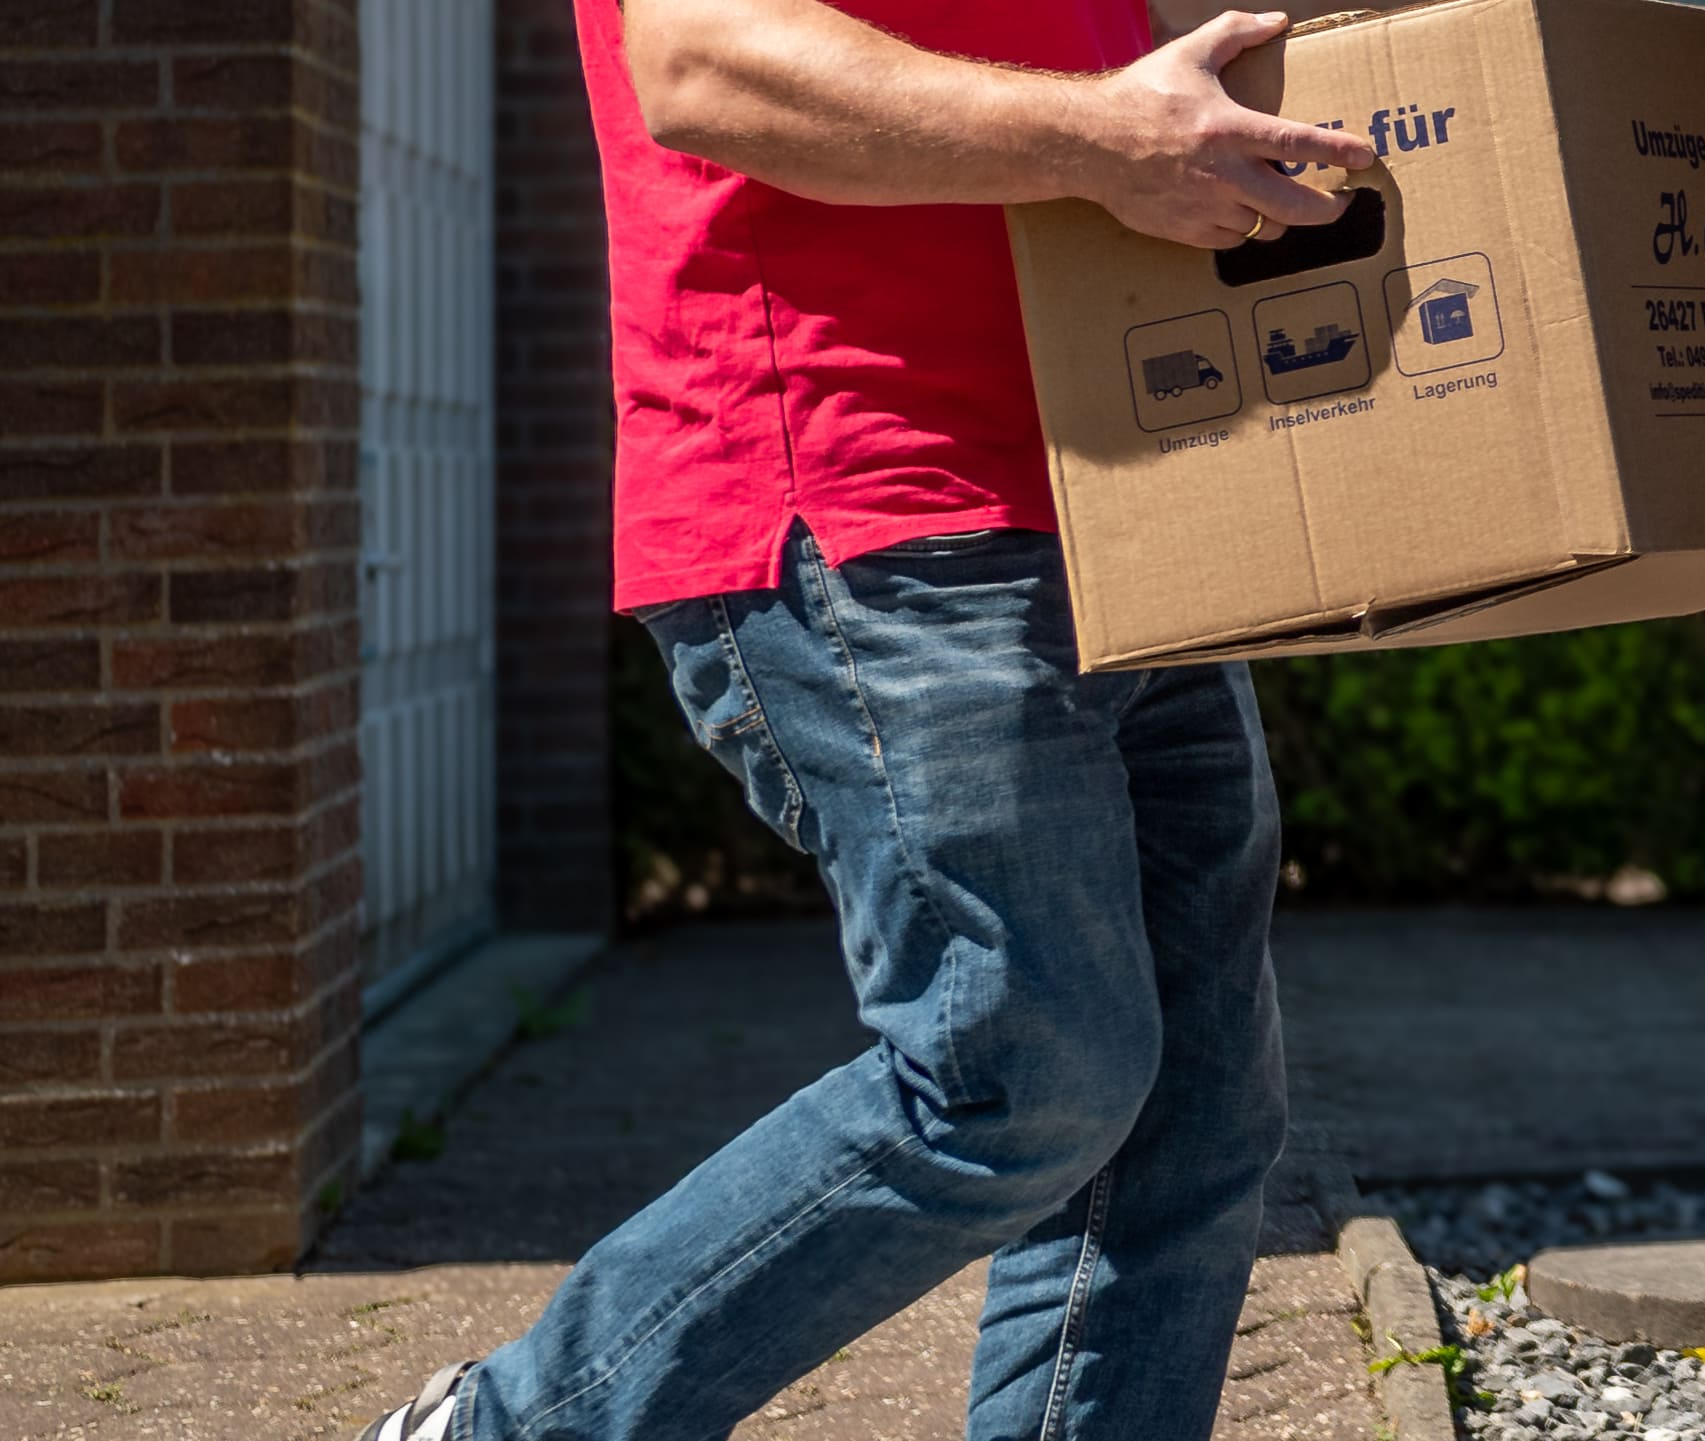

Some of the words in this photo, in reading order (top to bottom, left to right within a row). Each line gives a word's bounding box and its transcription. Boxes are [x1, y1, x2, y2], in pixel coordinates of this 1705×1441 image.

[1368, 103, 1456, 160] für
[1654, 190, 1699, 264] H.
[1646, 300, 1697, 331] 26427
[1413, 372, 1498, 402] Lagerung
[1269, 396, 1377, 432] Inselverkehr
